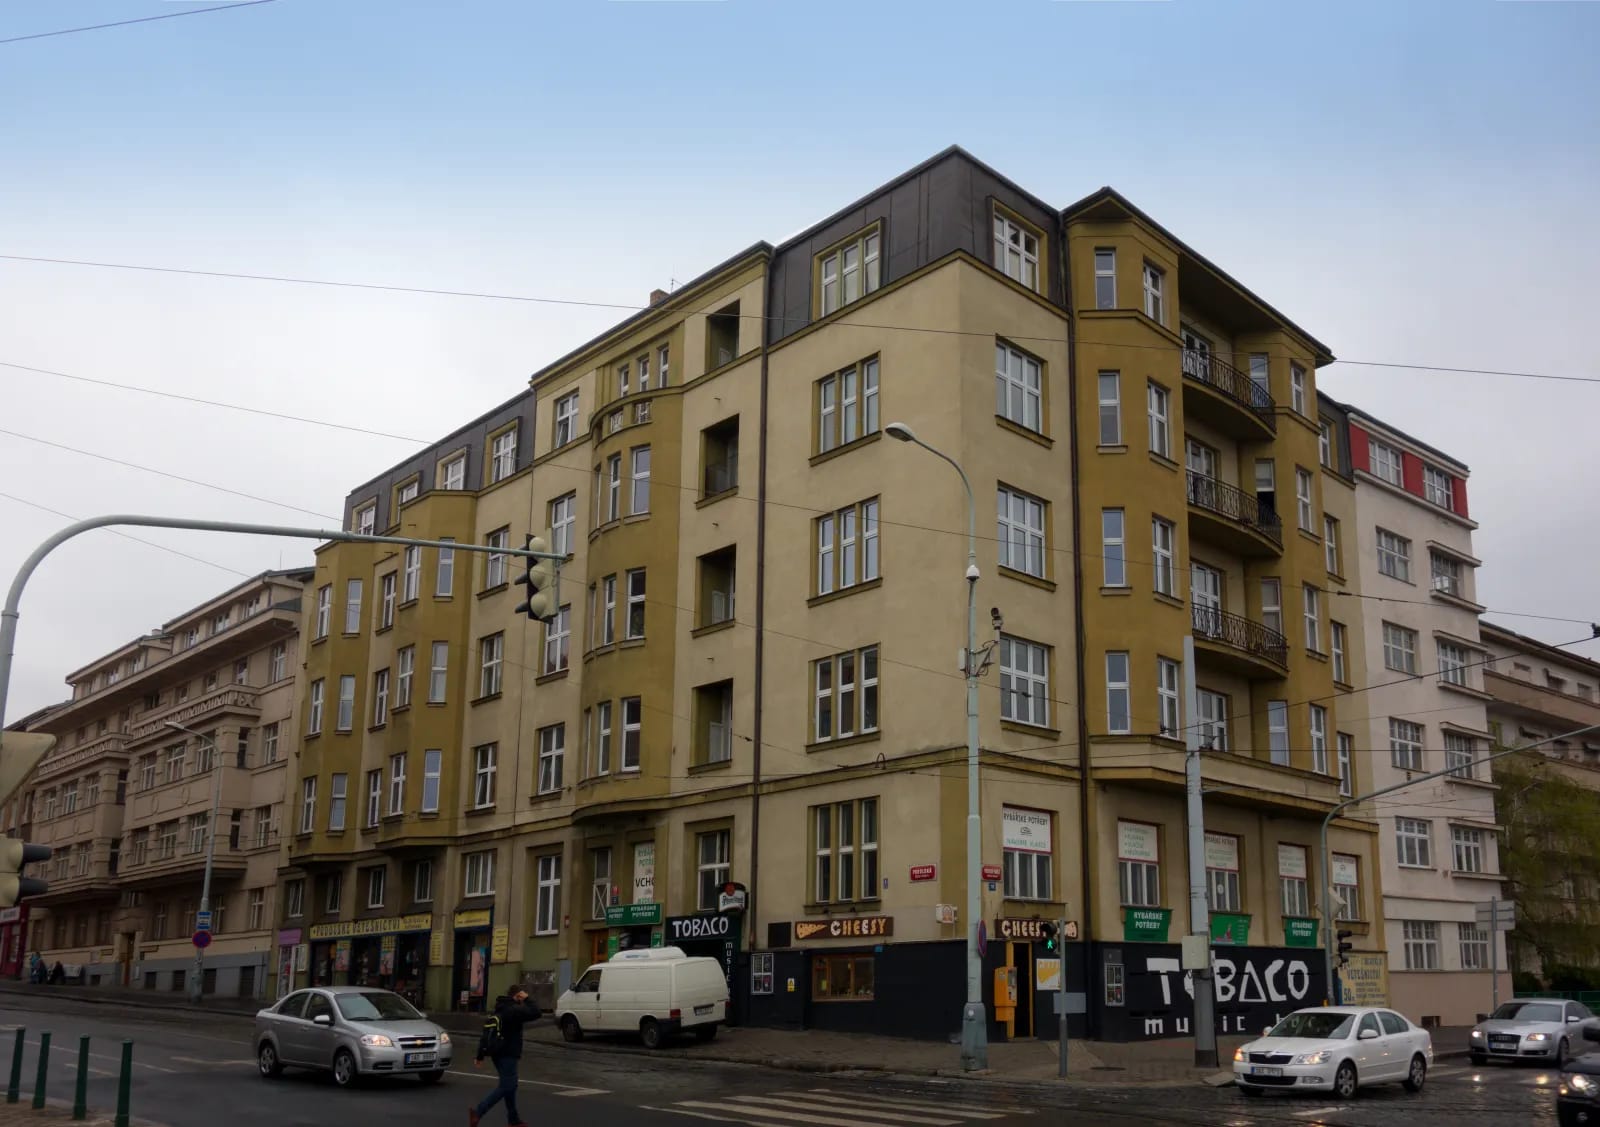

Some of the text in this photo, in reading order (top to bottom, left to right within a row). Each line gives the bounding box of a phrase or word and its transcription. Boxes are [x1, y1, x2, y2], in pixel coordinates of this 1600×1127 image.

[672, 916, 729, 938] TOBACO
[830, 918, 887, 936] CHEESY
[1001, 920, 1048, 938] CHEES
[1145, 1014, 1246, 1036] muic
